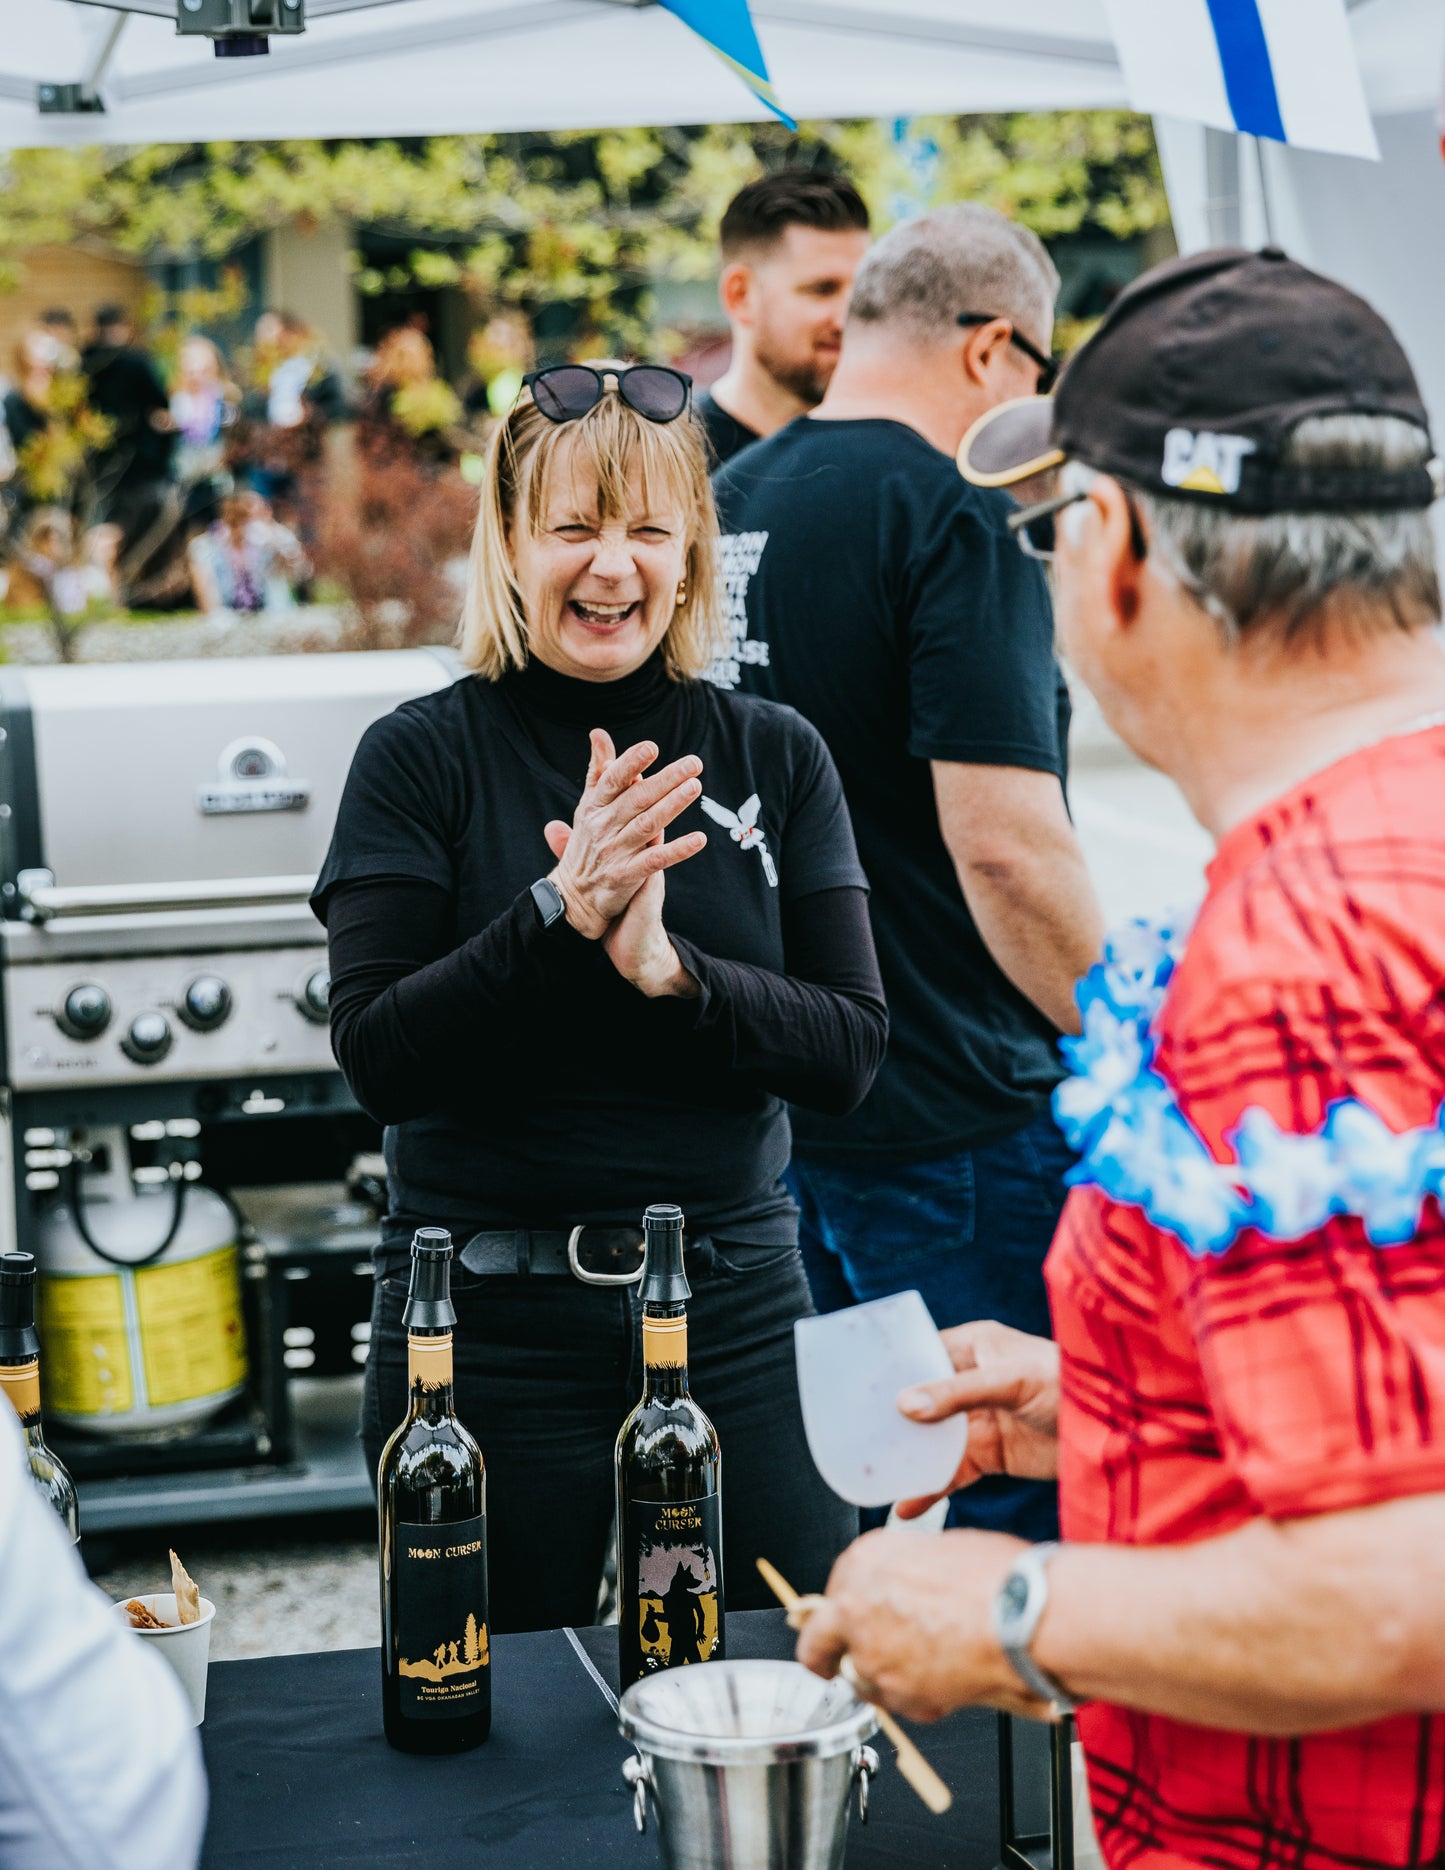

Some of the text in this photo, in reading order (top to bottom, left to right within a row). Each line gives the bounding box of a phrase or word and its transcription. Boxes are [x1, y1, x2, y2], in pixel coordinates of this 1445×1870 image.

[1161, 427, 1257, 494] CAT
[661, 1505, 697, 1518] MOON
[655, 1517, 702, 1530] CURSER
[408, 1540, 482, 1559] MOON CURSER
[420, 1680, 477, 1694] Touriga Nacional
[465, 1688, 480, 1697] VALLEY
